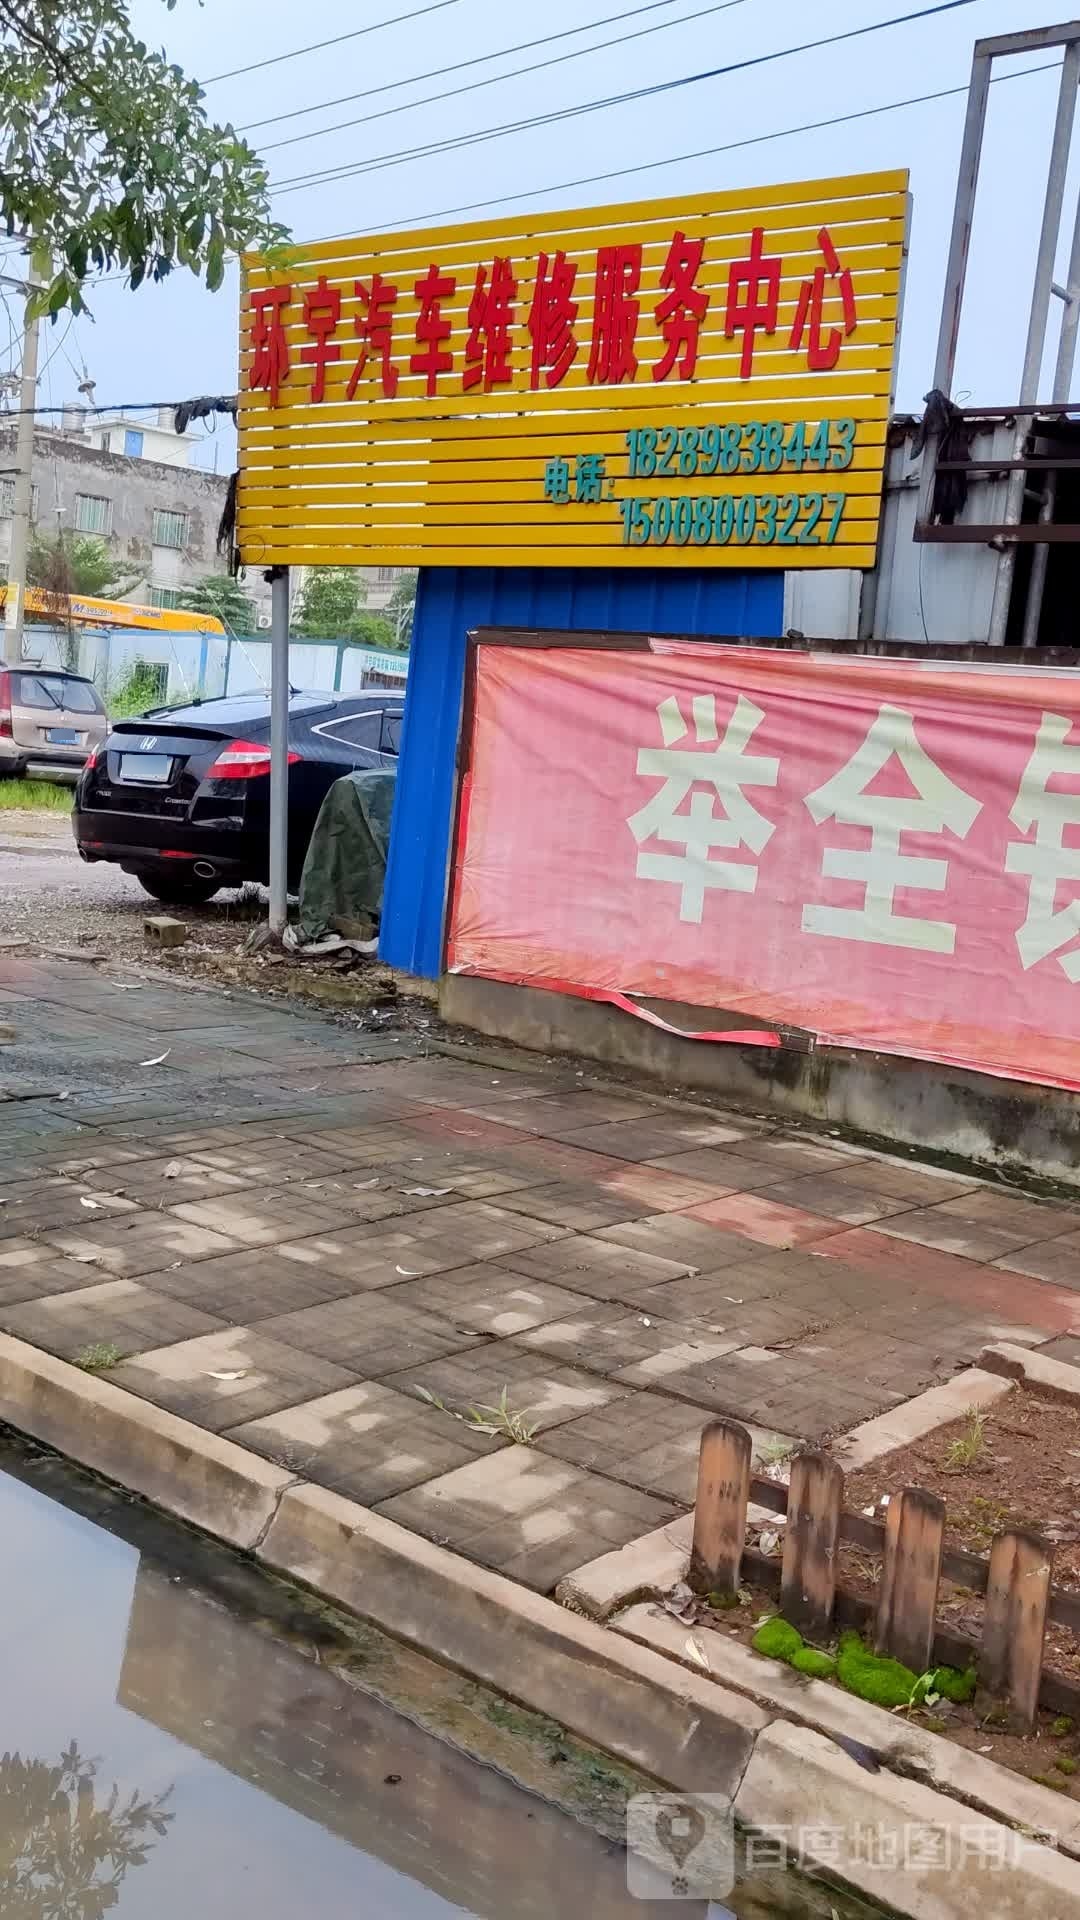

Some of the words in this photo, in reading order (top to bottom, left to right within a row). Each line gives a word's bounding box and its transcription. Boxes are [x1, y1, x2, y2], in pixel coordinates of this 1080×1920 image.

[249, 226, 857, 409] 环宇汽车维修服务中心
[625, 417, 857, 478] 18289838443
[619, 491, 847, 546] 15008003227
